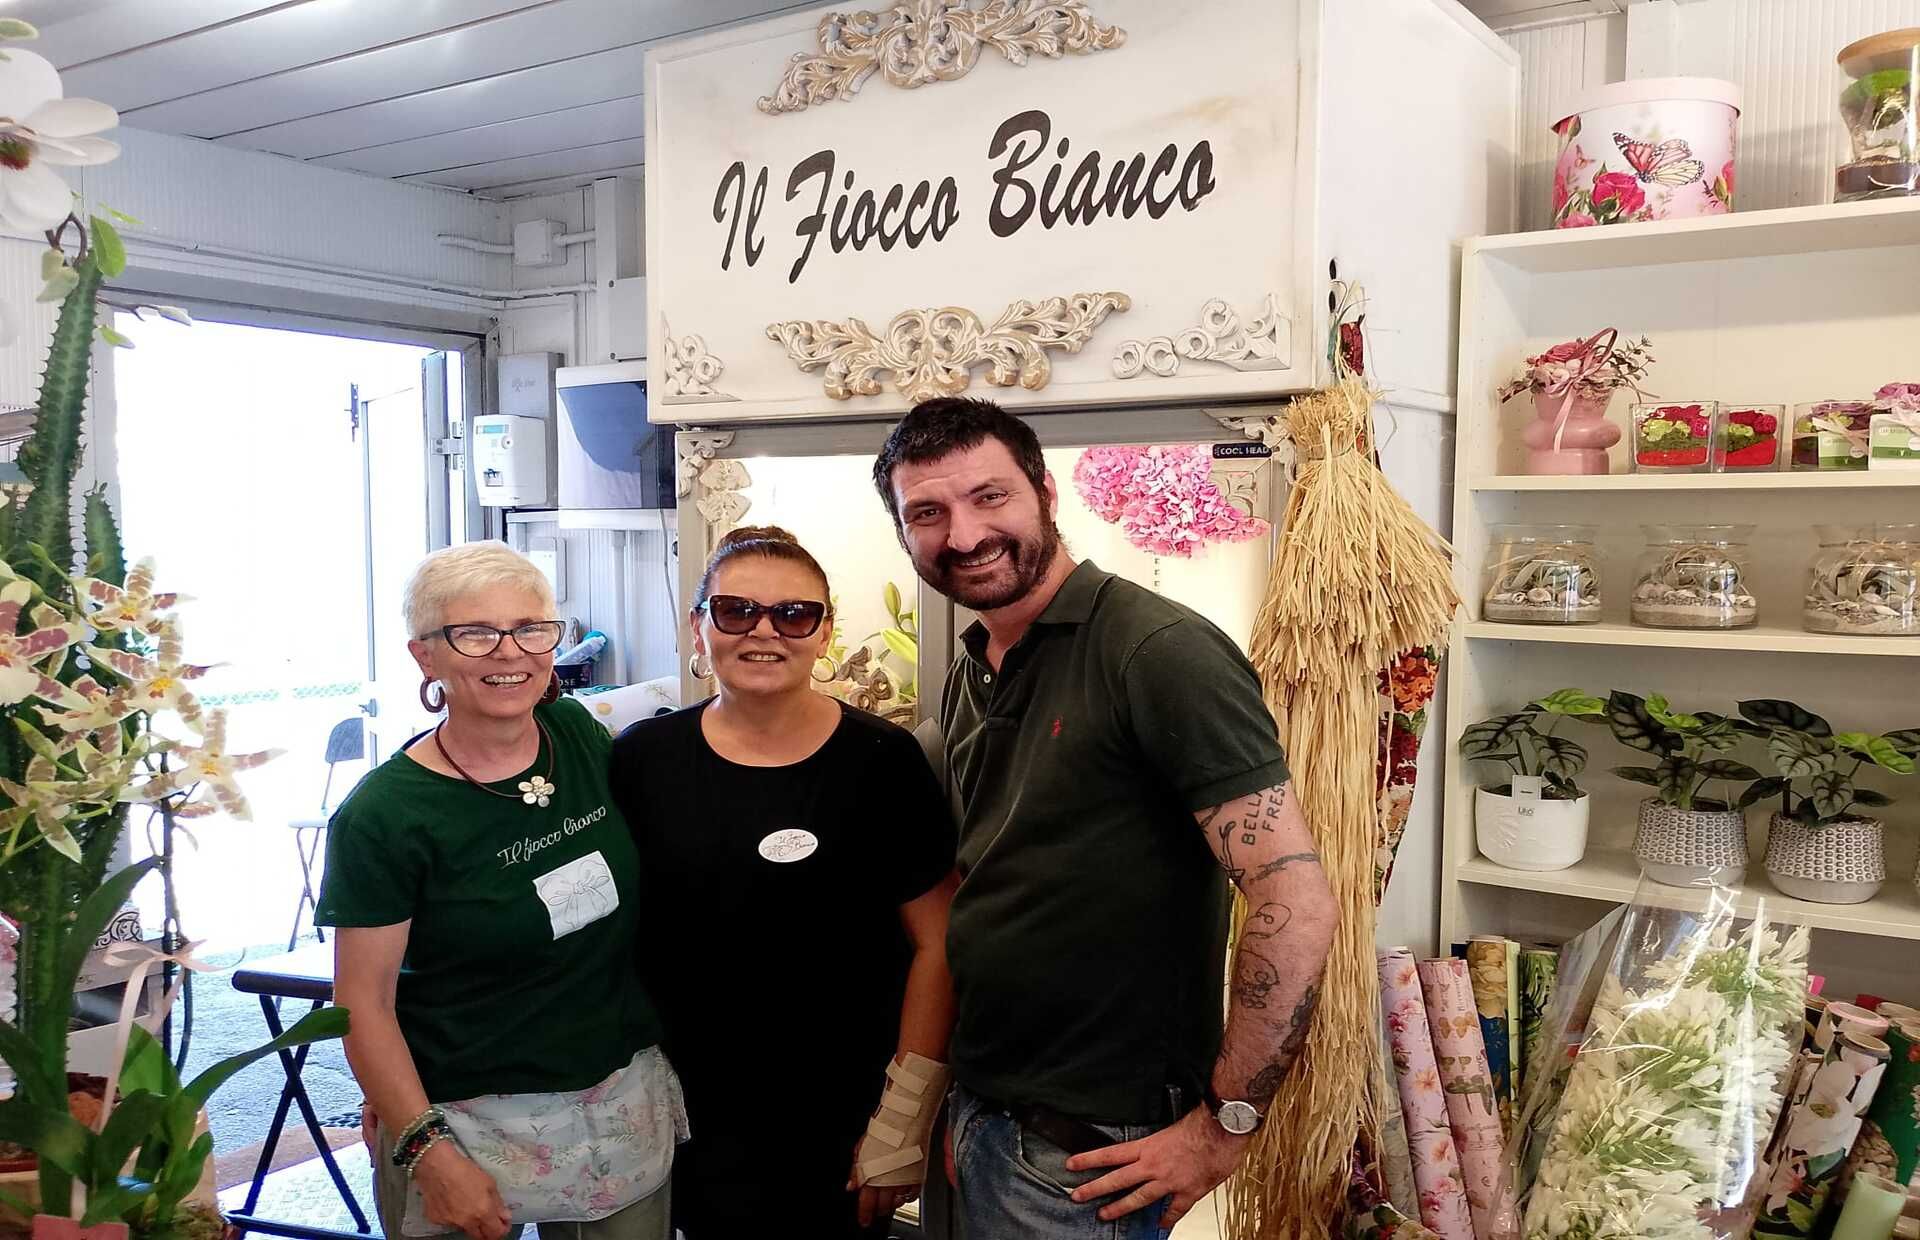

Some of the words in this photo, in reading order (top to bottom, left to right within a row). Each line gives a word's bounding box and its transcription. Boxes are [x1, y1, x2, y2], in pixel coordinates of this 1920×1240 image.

[713, 161, 769, 271] Il
[786, 150, 960, 284] Fiocco
[988, 109, 1216, 238] Bianco
[1245, 446, 1269, 454] HEAD
[496, 840, 522, 869] Il
[523, 830, 562, 862] fiocco
